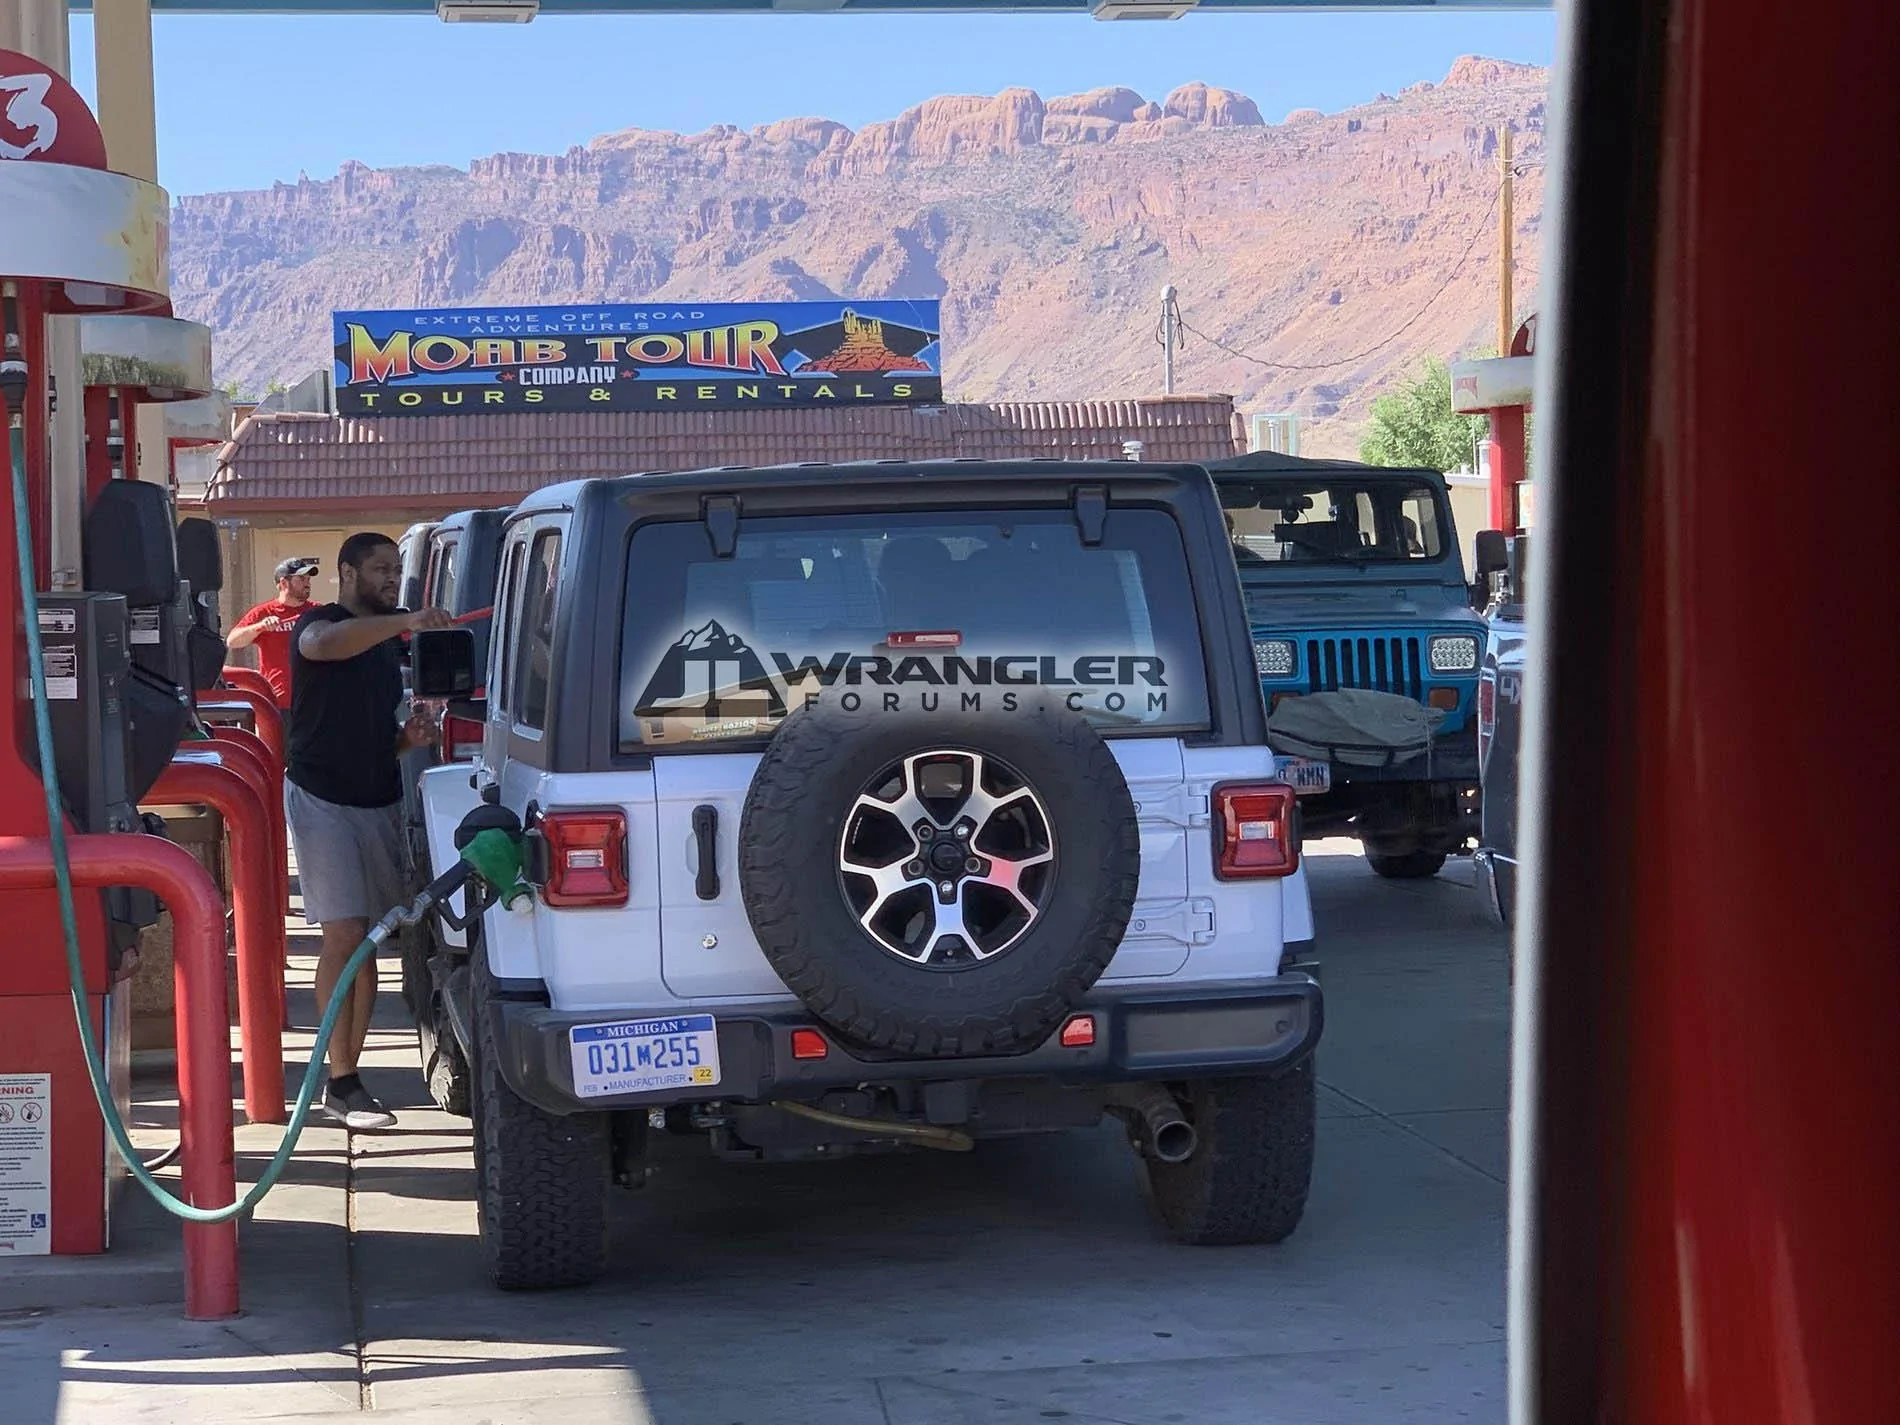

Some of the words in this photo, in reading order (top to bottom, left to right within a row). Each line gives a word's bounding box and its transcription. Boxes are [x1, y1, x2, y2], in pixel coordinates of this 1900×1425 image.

[0, 73, 58, 160] 3
[415, 314, 539, 325] EXTREME
[561, 312, 611, 321] OFF
[634, 311, 705, 321] ROAD
[471, 322, 650, 334] ADVENTURES
[346, 323, 567, 384] MOAB
[585, 320, 789, 376] TOUR
[519, 366, 616, 386] COMPANY
[360, 389, 543, 406] TOURS
[589, 388, 610, 401] &
[657, 384, 912, 400] RENTALS
[607, 1021, 679, 1038] MICHIGAN
[588, 1036, 700, 1075] 031M255
[700, 1069, 712, 1078] 22
[0, 1086, 35, 1095] NING
[584, 1084, 598, 1093] FEB
[609, 1074, 687, 1090] MANUFACTURER
